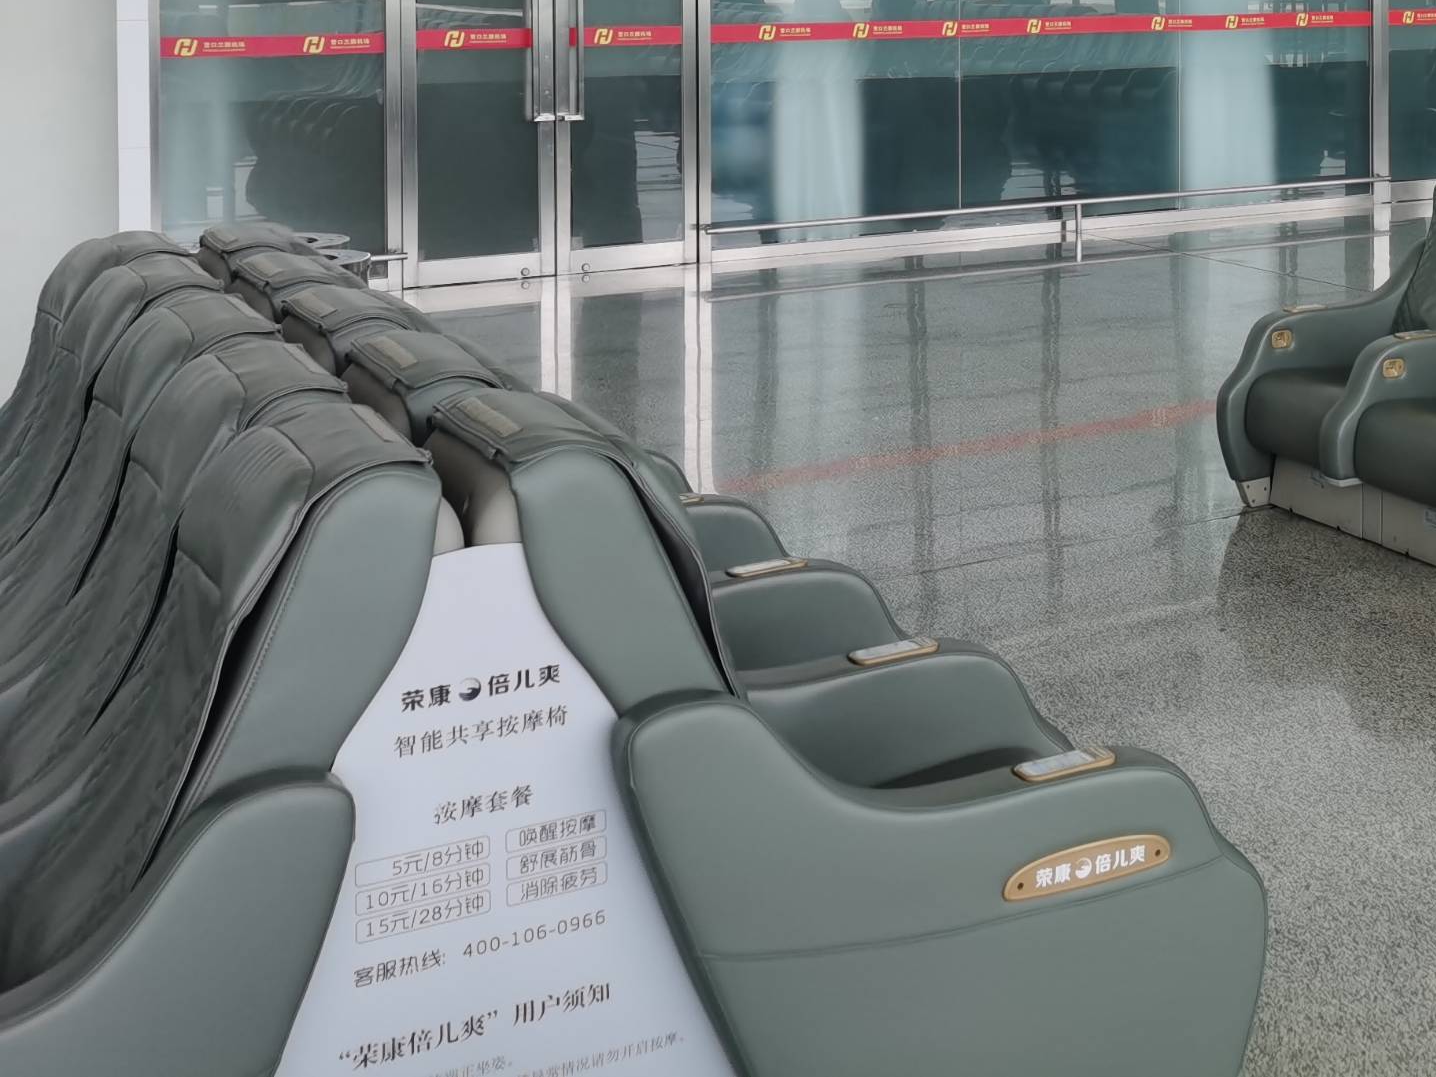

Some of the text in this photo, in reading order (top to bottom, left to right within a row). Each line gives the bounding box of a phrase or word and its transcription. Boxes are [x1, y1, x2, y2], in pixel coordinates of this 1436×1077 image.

[401, 664, 561, 713] 荣康 倍儿爽
[393, 704, 569, 758] 智能共享按摩椅
[434, 784, 534, 825] 按摩套餐
[518, 813, 597, 847] 唤醒按摩
[392, 840, 485, 876] 5元/8分钟
[519, 842, 597, 873] 舒展筋骨
[1035, 844, 1146, 888] 荣康 倍儿爽
[365, 867, 485, 910] 10元/16分钟
[520, 867, 598, 901] 消除疲劳
[365, 894, 485, 937] 15元/28分钟
[462, 909, 607, 958] 400-106-0966
[512, 982, 611, 1027] 用户须知
